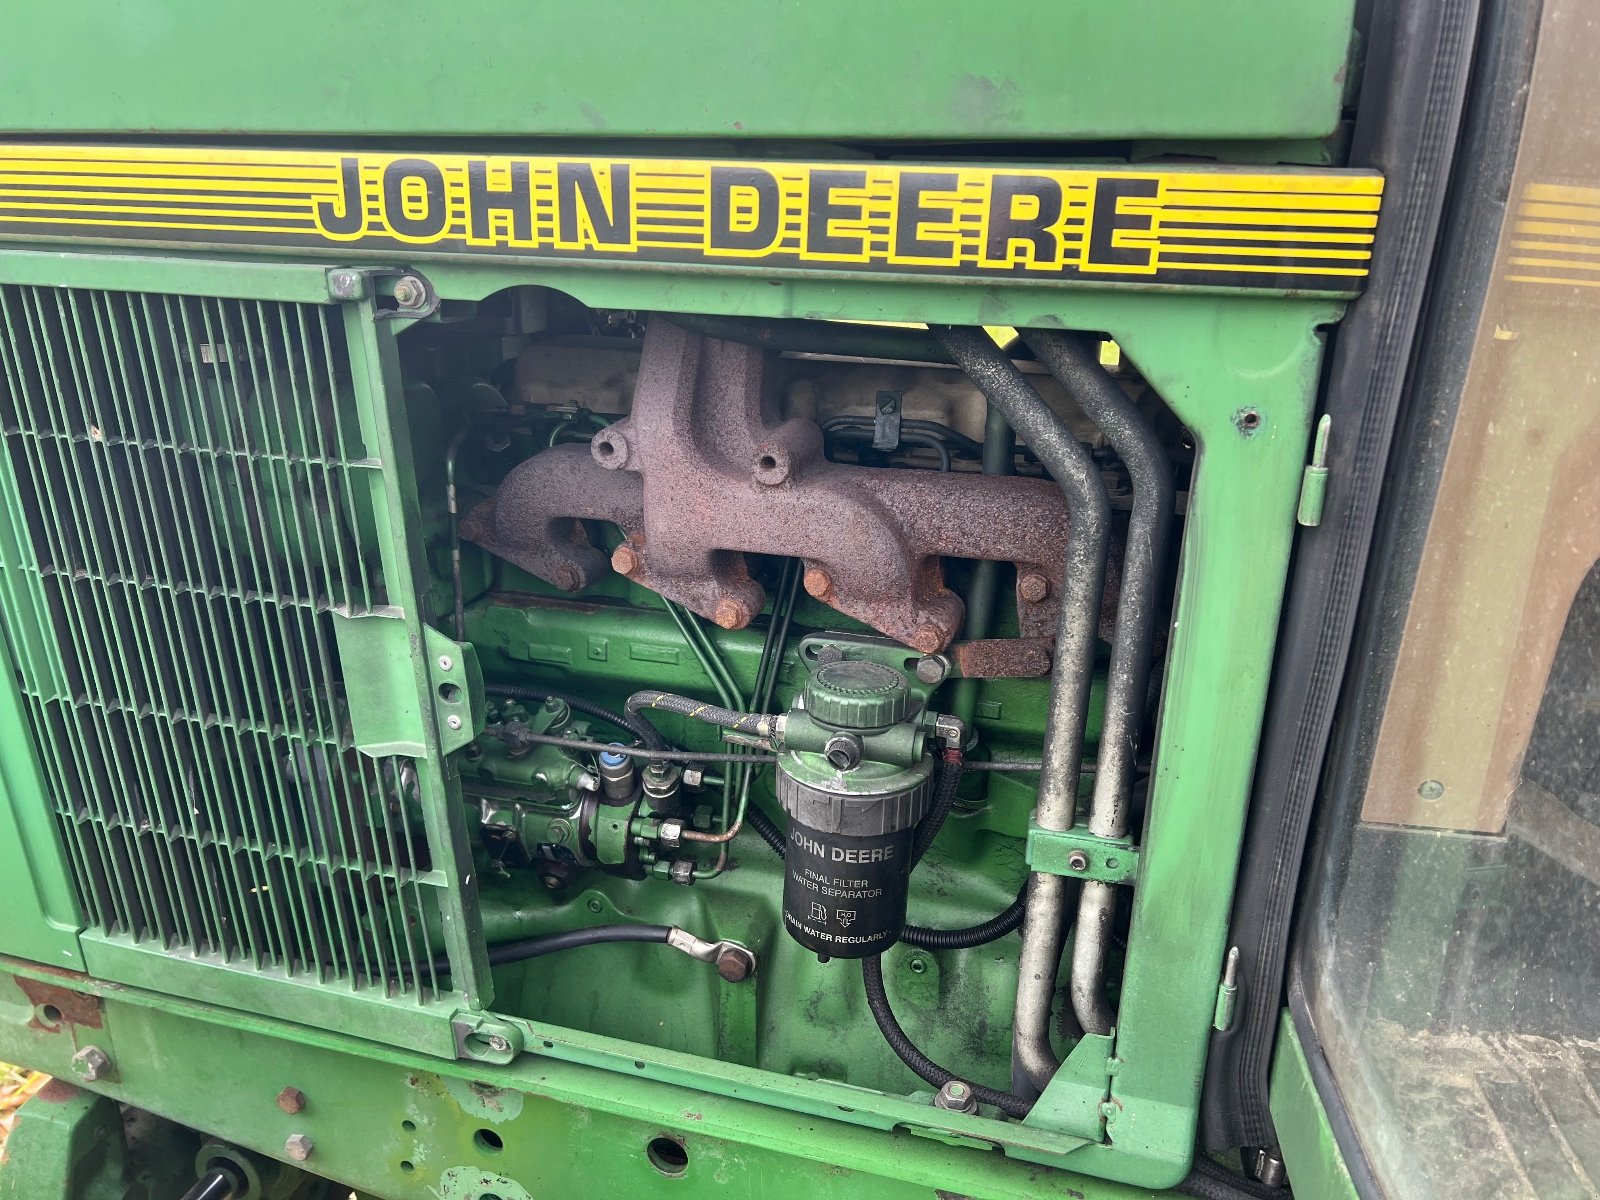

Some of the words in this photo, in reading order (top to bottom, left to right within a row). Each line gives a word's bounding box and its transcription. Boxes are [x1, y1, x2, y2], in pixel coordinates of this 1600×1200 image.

[312, 157, 637, 252] JOHN
[704, 165, 1160, 274] DEERE
[791, 827, 825, 858] JOHN
[832, 845, 894, 863] DEERE
[792, 869, 819, 892] WATER
[821, 886, 882, 899] SEPARATOR
[804, 868, 830, 885] FINAL
[833, 878, 868, 888] FILTER
[803, 925, 832, 942] WATER
